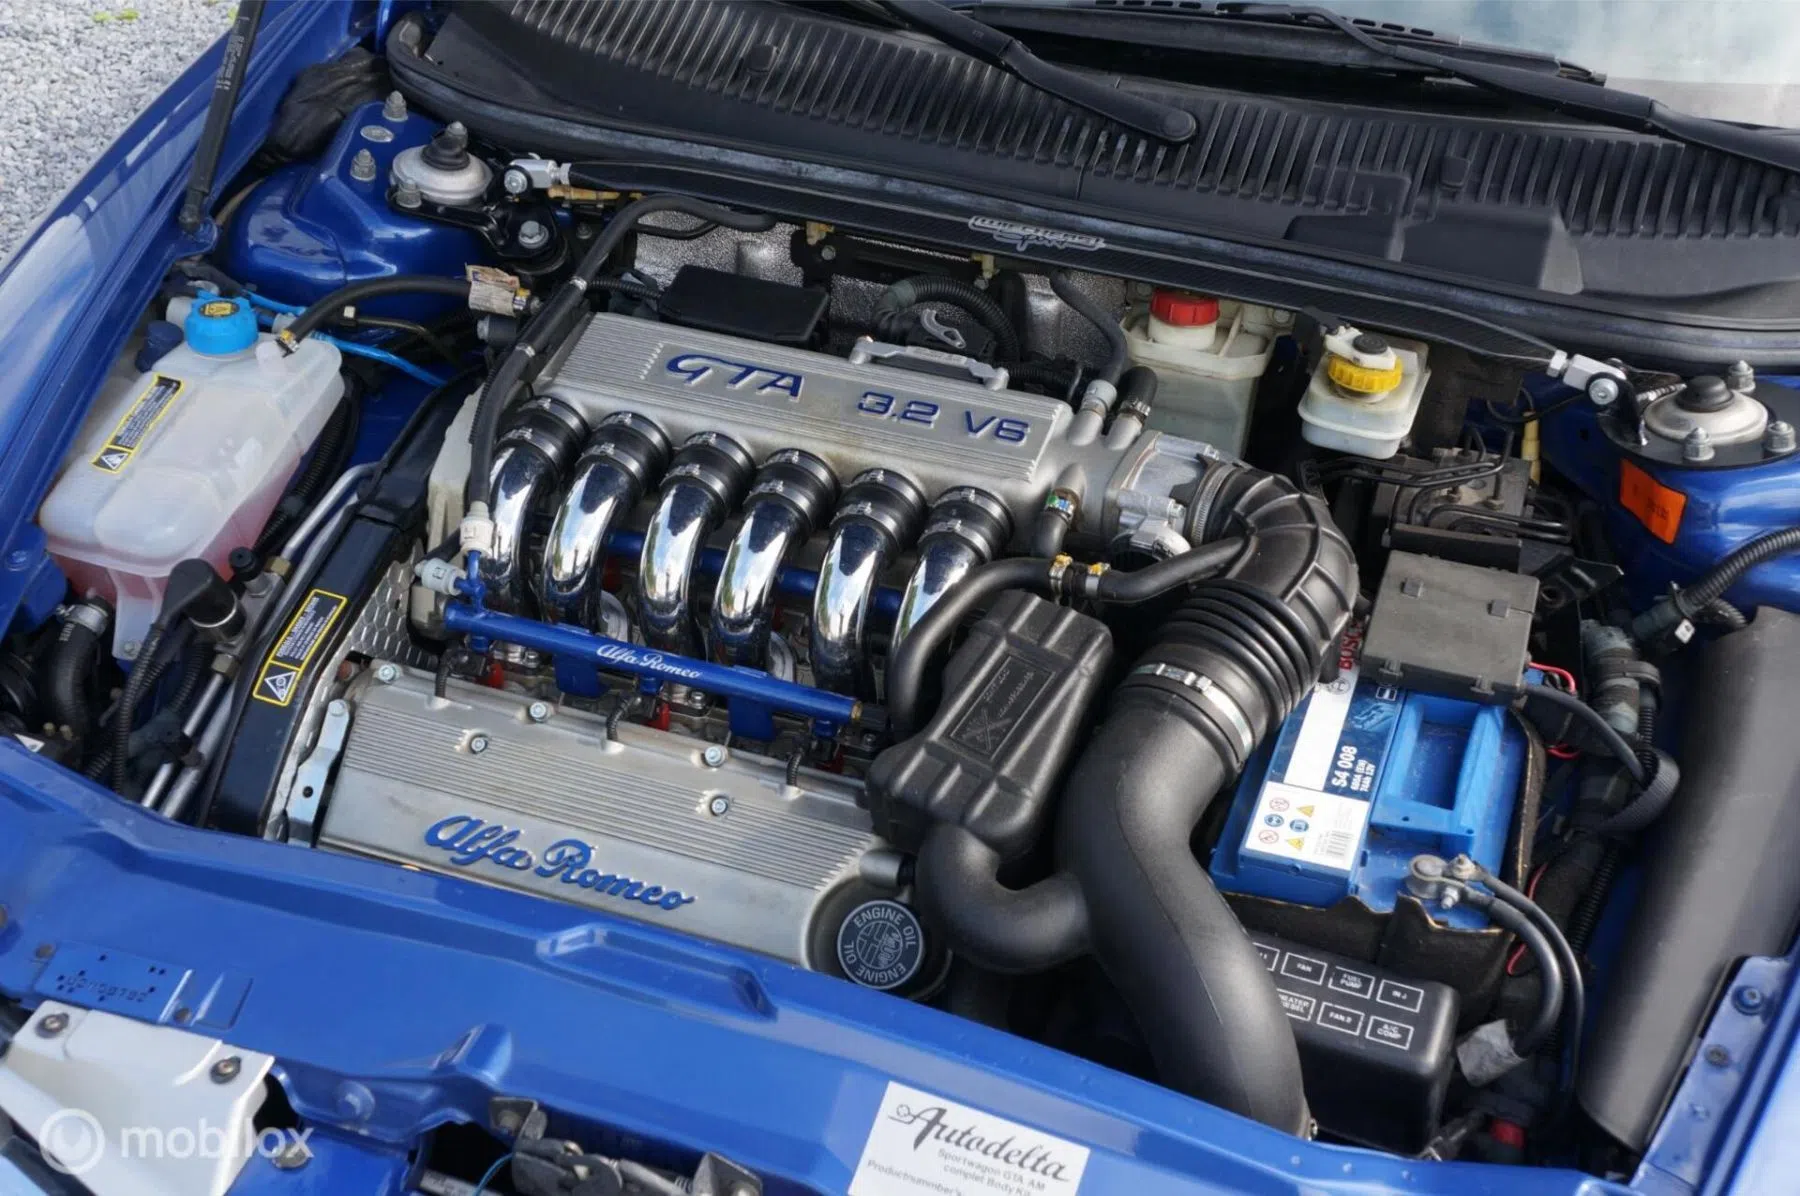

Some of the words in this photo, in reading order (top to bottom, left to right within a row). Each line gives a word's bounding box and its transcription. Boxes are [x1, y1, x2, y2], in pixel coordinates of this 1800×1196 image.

[666, 353, 804, 400] GTA
[857, 391, 941, 428] 3.2
[964, 410, 1031, 445] V6
[596, 643, 640, 665] Alfa
[638, 653, 703, 679] Romeo
[1331, 769, 1351, 788] S4
[1336, 745, 1358, 769] 008
[424, 814, 534, 870] Alfa
[534, 838, 698, 911] Romeo
[852, 907, 906, 929] ENGINE
[902, 925, 917, 950] OIL
[843, 940, 858, 965] OIL
[855, 962, 907, 984] ENGINE
[887, 1104, 1070, 1182] Autodelta
[1002, 1169, 1024, 1185] GTA
